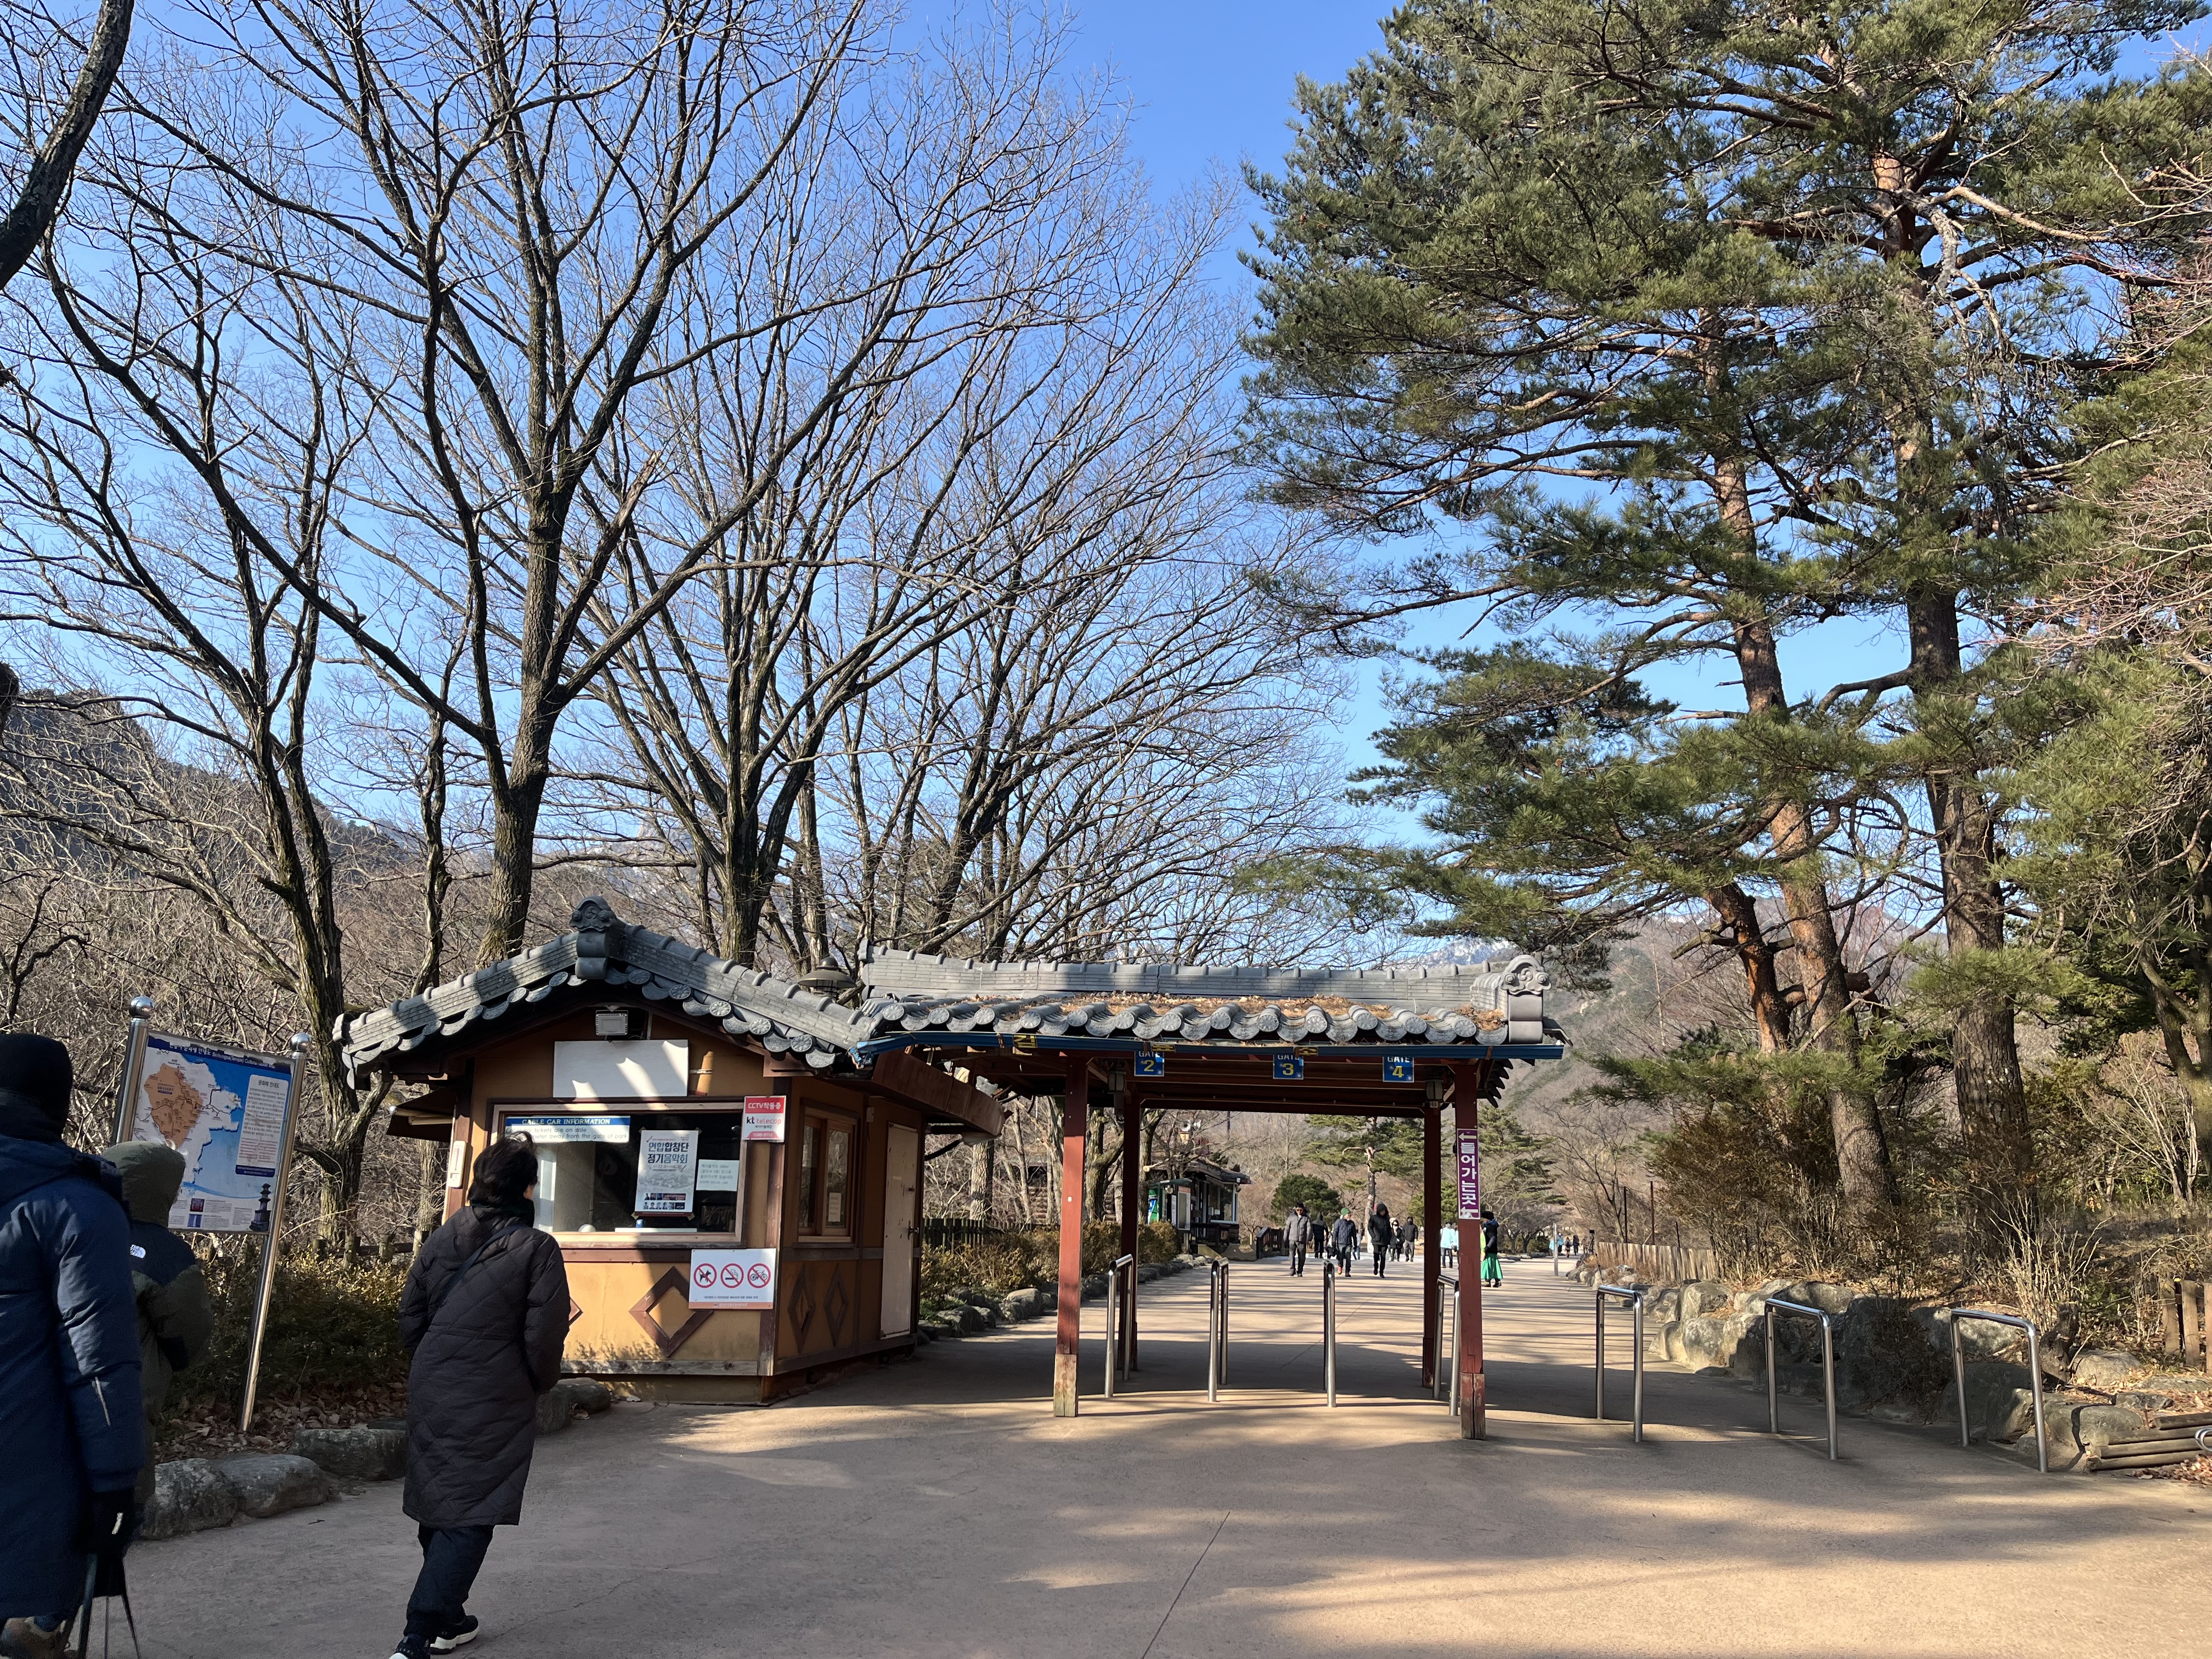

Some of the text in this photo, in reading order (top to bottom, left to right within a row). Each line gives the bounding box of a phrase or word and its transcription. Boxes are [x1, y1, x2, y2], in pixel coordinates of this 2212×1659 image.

[1144, 1059, 1155, 1071] 2
[1283, 1063, 1294, 1076] 3
[1392, 1065, 1404, 1078] 4
[747, 1116, 755, 1124] kt
[649, 1142, 690, 1152] 연합합창단
[647, 1154, 689, 1164] 정기음악회
[1460, 1142, 1477, 1205] 들어가는곳
